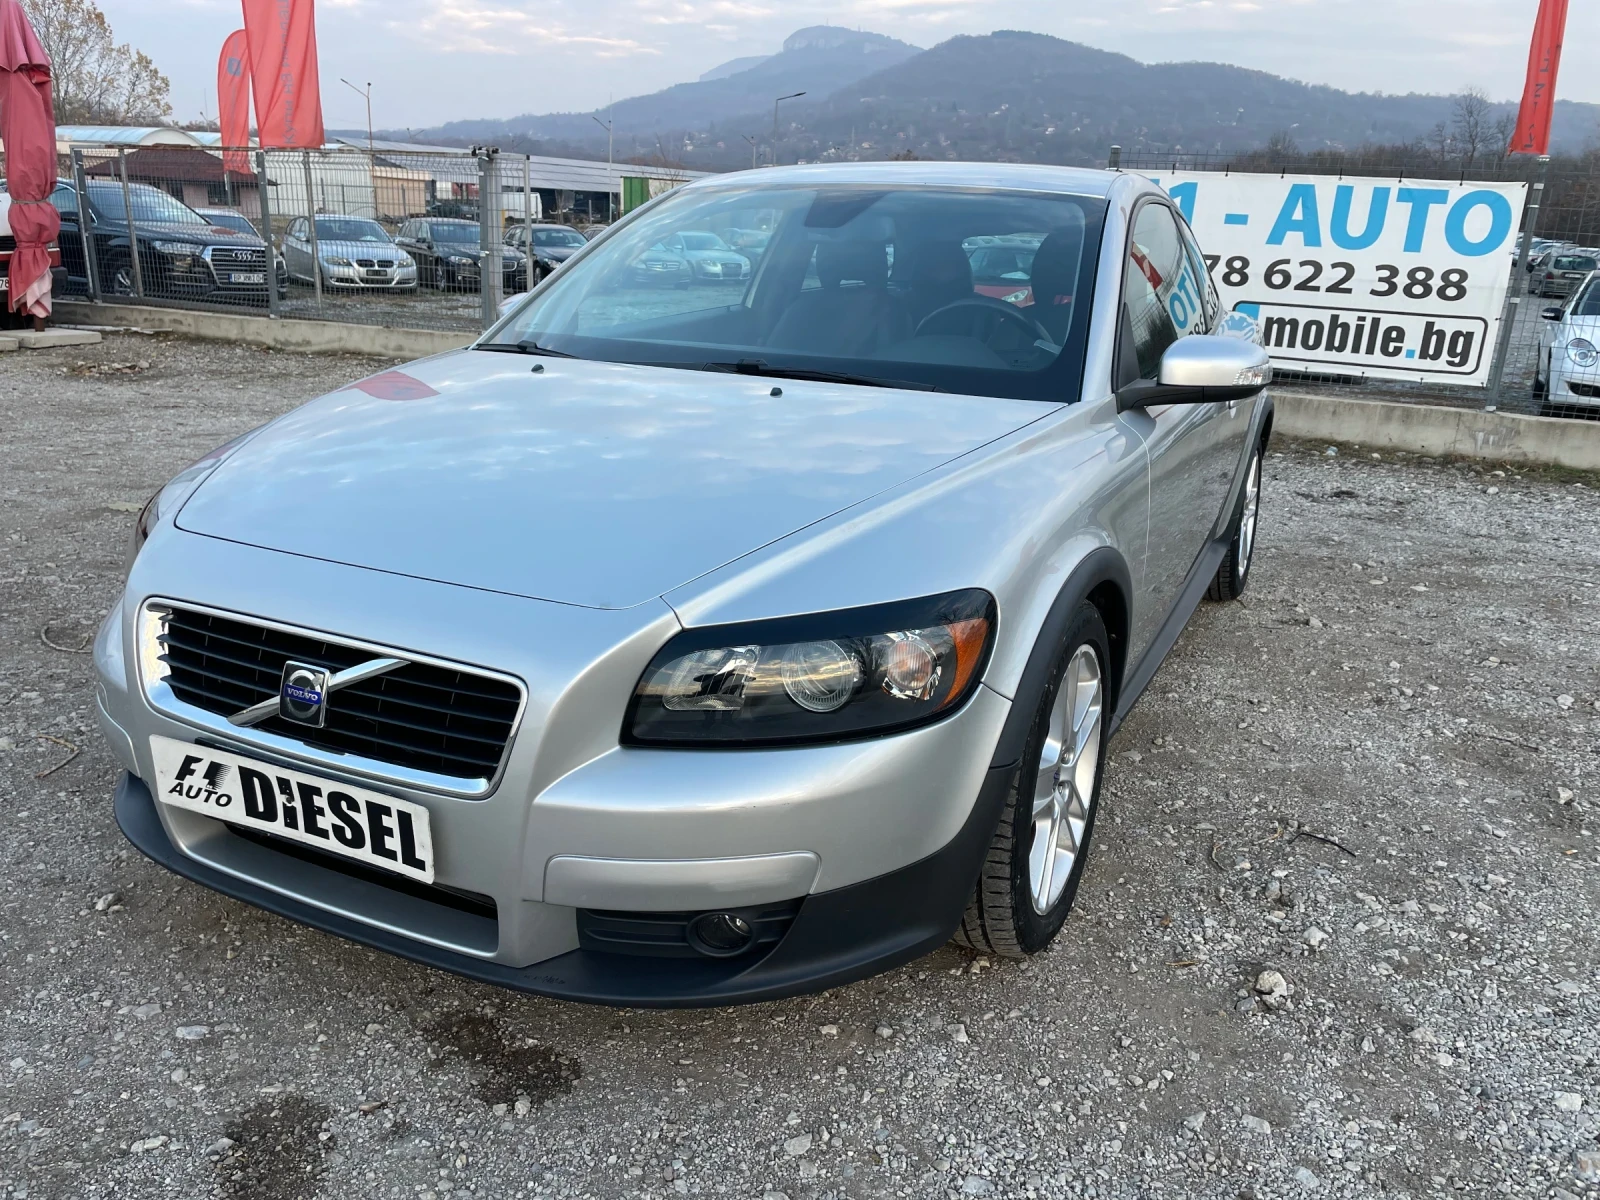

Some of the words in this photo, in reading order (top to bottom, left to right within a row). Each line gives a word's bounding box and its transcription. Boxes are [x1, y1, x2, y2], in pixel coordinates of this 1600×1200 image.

[1266, 183, 1513, 257] AUTO
[1263, 258, 1356, 294] 622
[1370, 264, 1469, 301] 388
[1264, 314, 1475, 367] mobile.bg
[287, 687, 318, 701] VOLVO
[169, 781, 232, 807] AUTO
[238, 765, 426, 872] DIESEL
